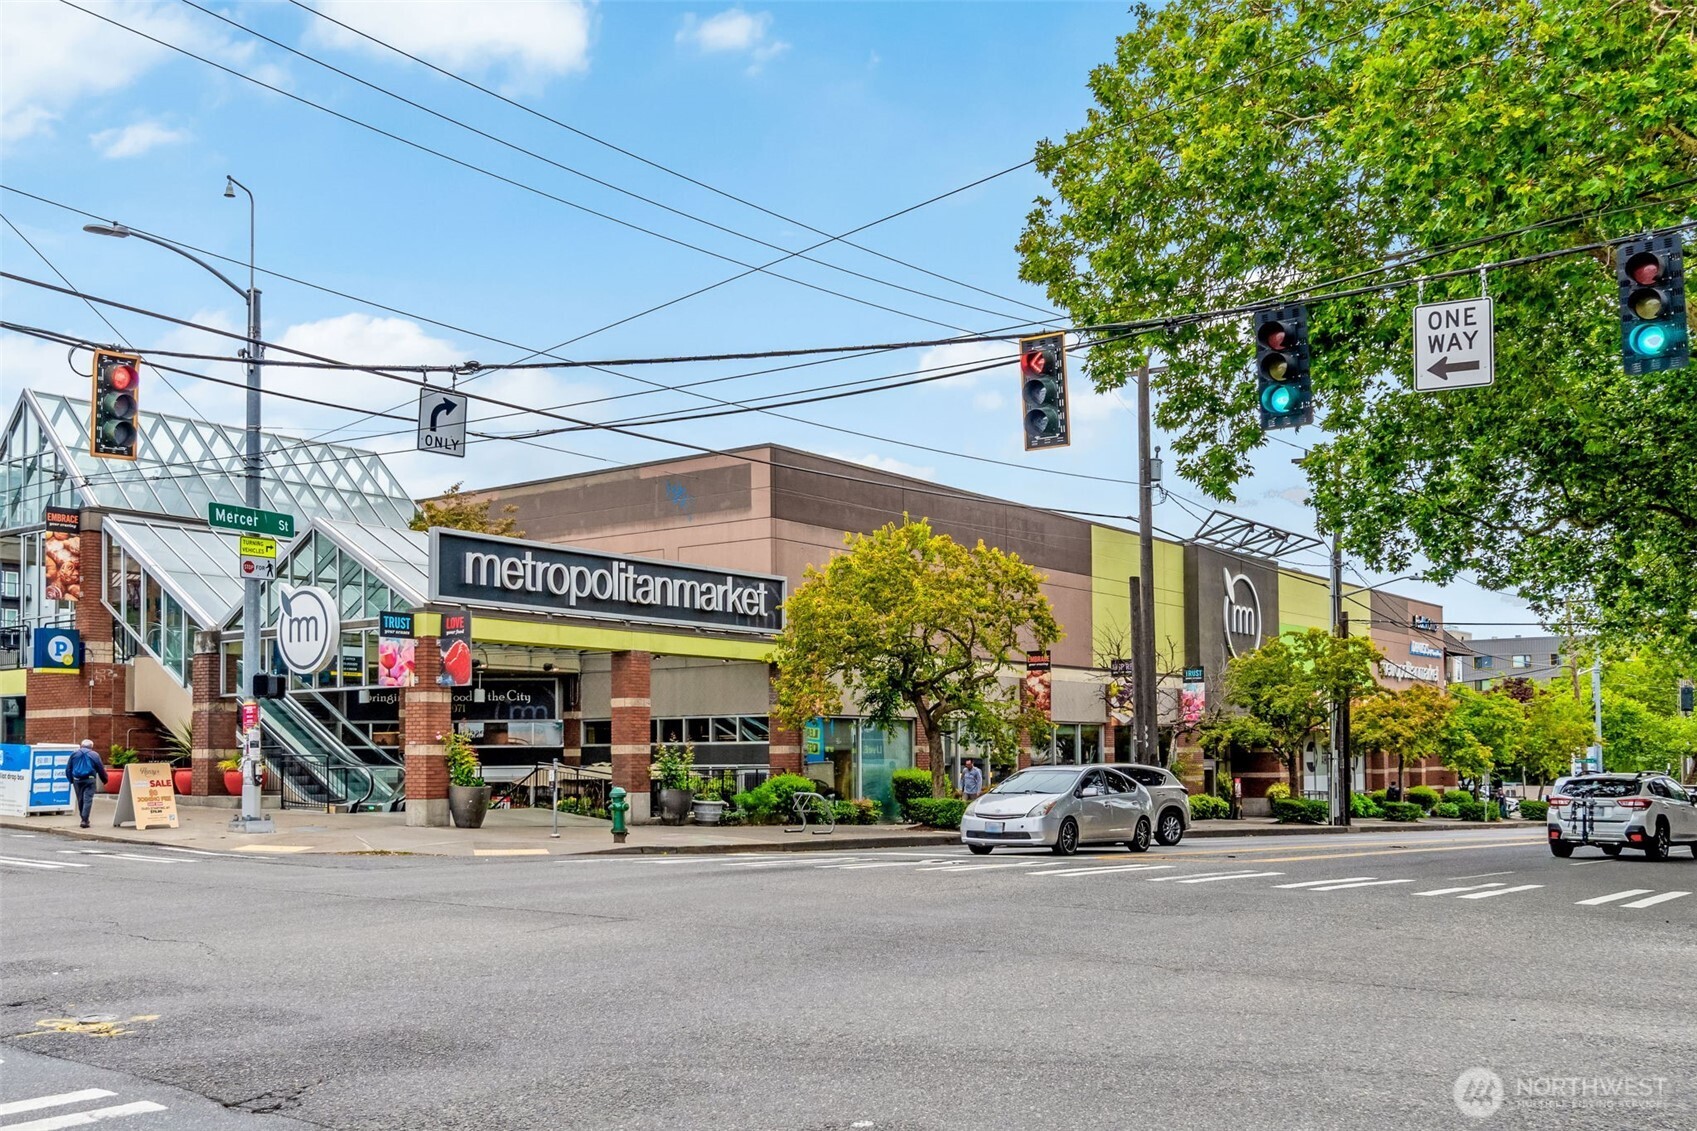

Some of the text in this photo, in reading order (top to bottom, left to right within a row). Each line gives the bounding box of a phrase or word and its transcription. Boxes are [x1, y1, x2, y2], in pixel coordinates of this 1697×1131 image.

[1428, 307, 1477, 330] ONE
[1428, 330, 1478, 354] WAY
[425, 434, 459, 451] ONLY
[47, 512, 79, 524] EMBRACE
[215, 508, 289, 532] Mercer St
[243, 539, 264, 547] TURNING
[242, 547, 265, 555] VEHICLES
[244, 563, 255, 571] STOP
[464, 551, 768, 617] metropolitanmarket
[383, 616, 411, 630] TRUST
[445, 616, 465, 630] LOVE
[54, 641, 68, 657] P
[368, 693, 400, 704] ringi
[453, 689, 531, 704] ood the City
[149, 779, 172, 788] SALE
